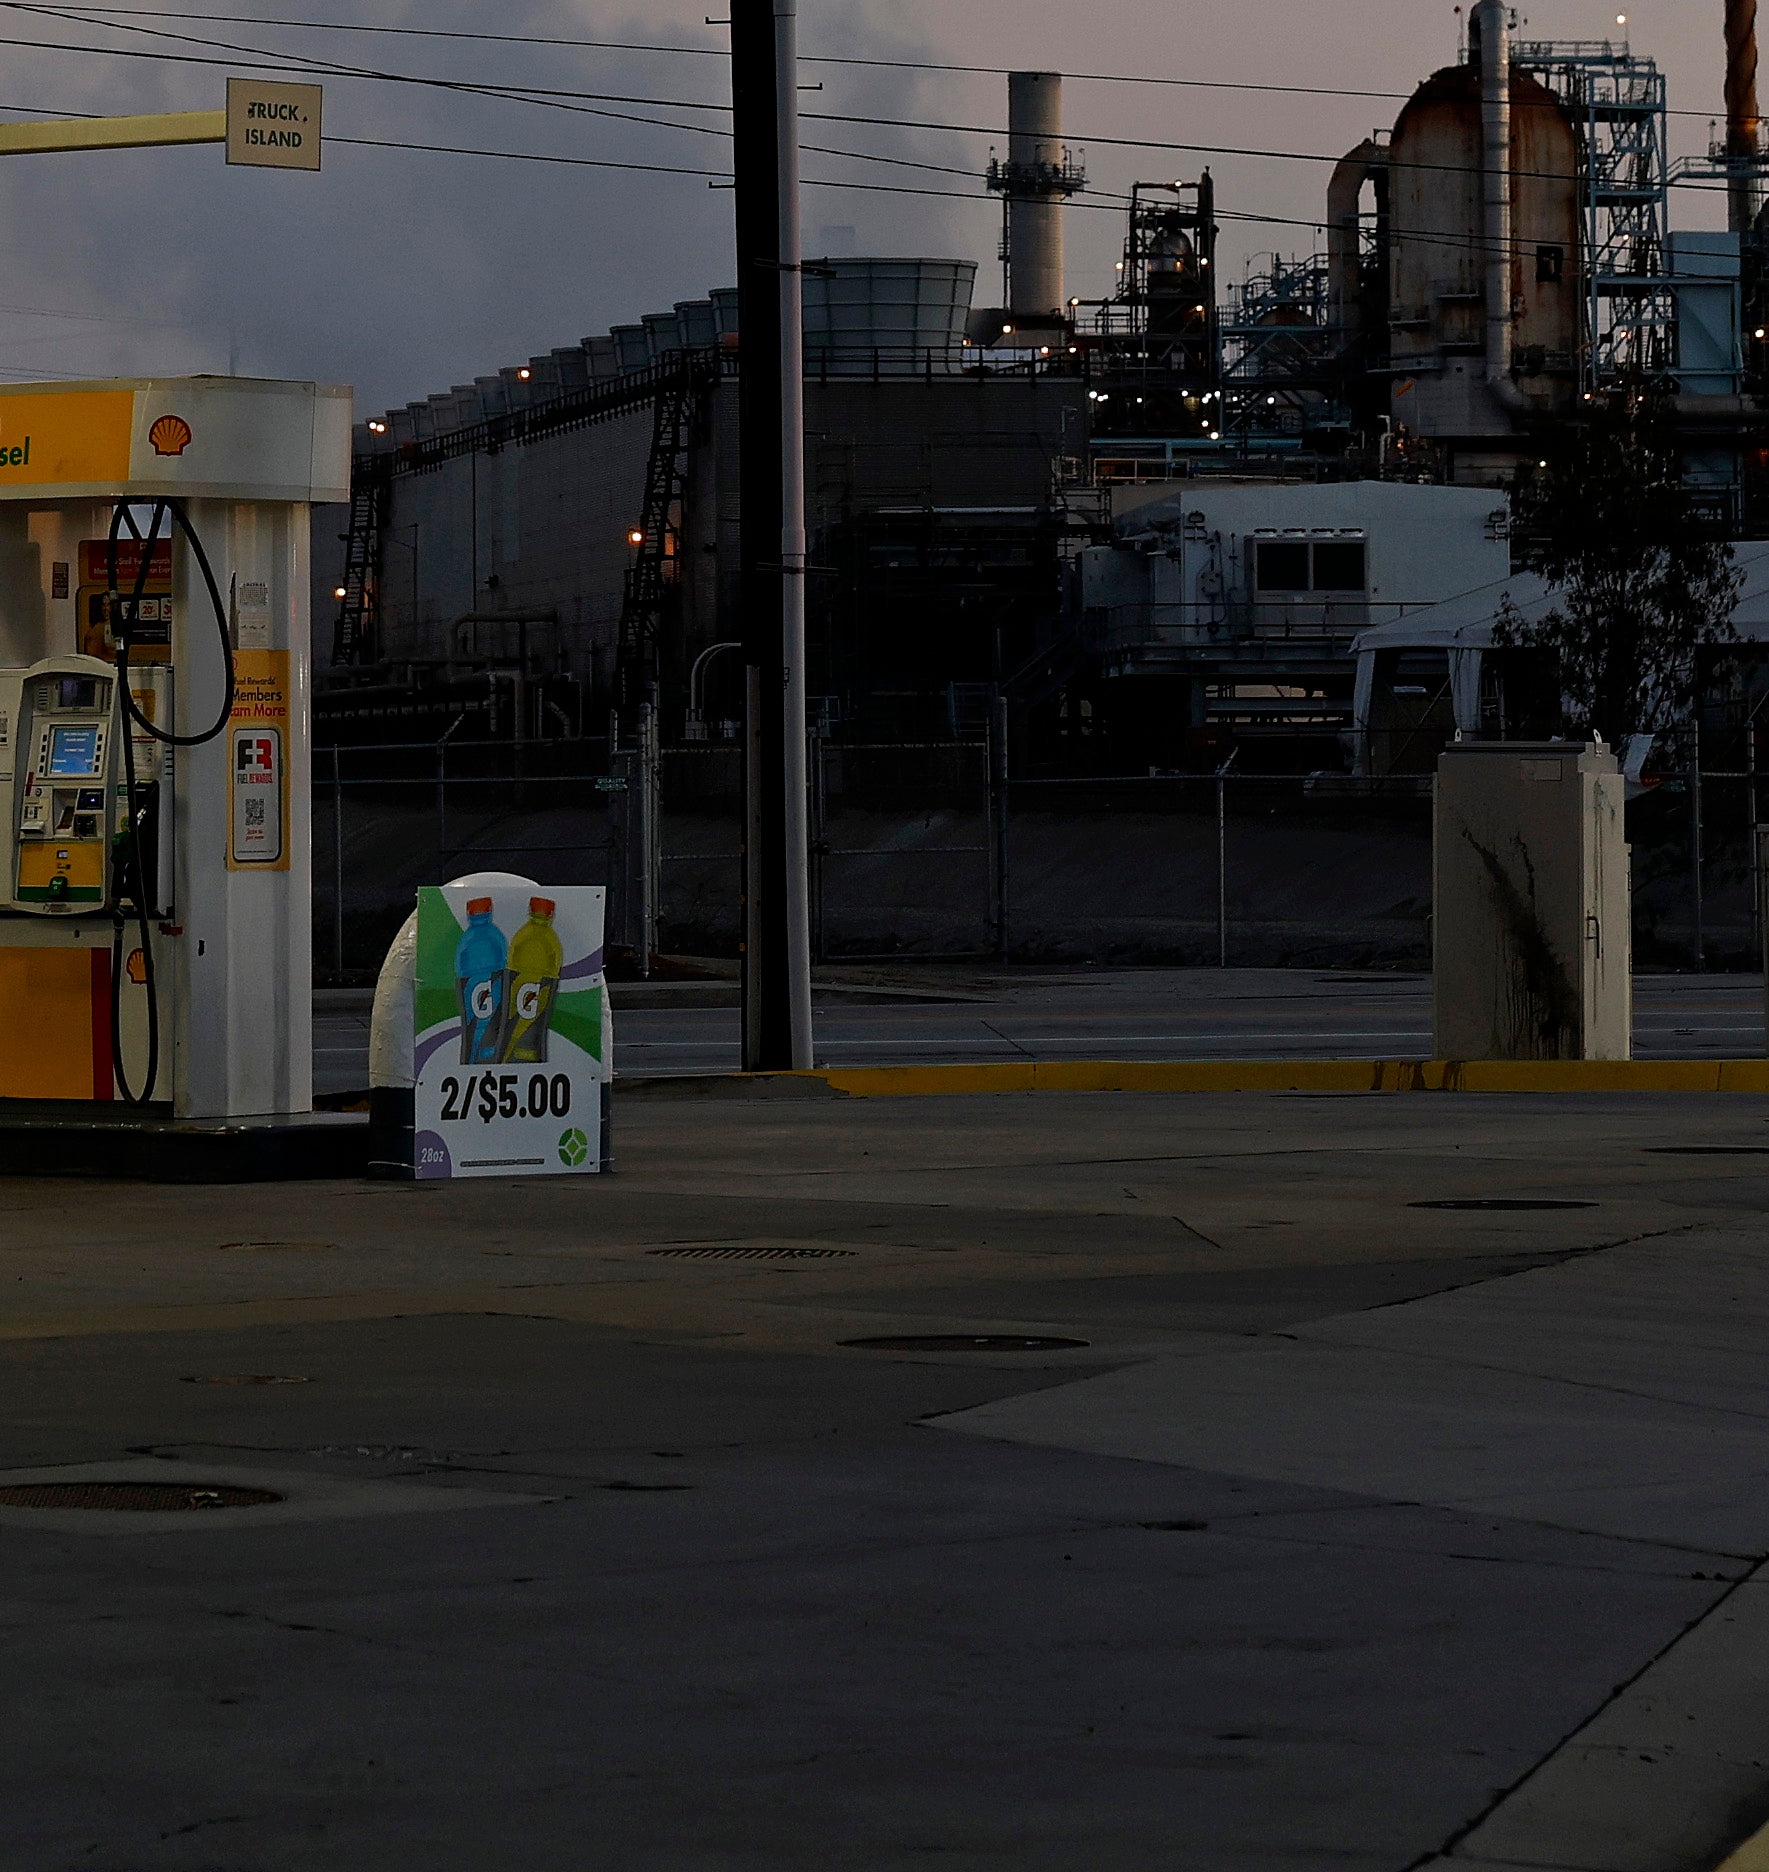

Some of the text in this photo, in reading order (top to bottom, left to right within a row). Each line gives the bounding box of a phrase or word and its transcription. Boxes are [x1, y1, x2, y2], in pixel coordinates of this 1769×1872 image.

[246, 129, 301, 147] ISLAND
[254, 703, 286, 717] More
[237, 773, 273, 784] FUEL REWARDS
[471, 979, 493, 1020] G
[517, 982, 540, 1020] G
[441, 1070, 571, 1124] 2/$5.00
[421, 1147, 445, 1164] 28oz
